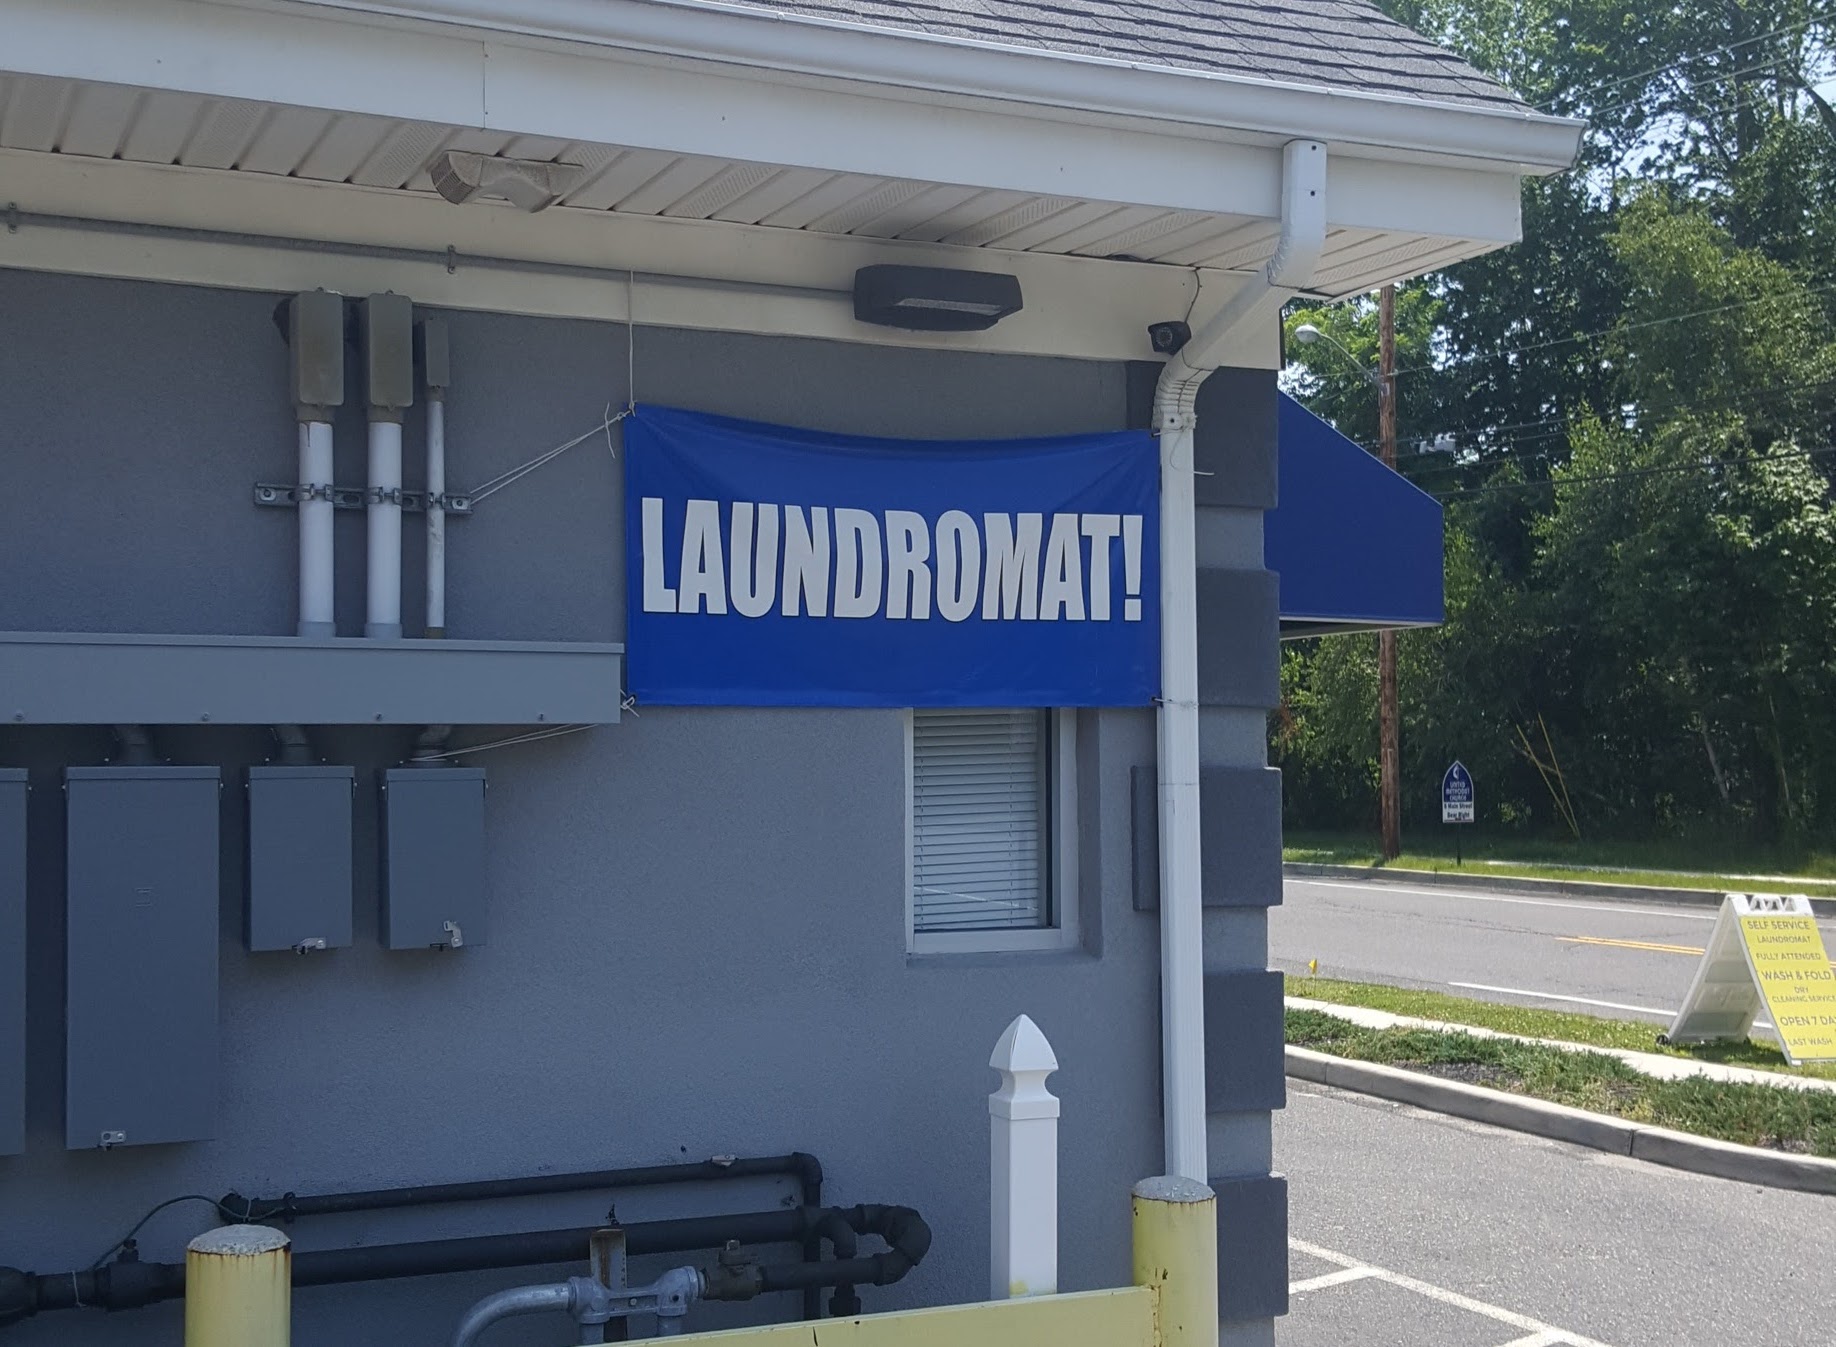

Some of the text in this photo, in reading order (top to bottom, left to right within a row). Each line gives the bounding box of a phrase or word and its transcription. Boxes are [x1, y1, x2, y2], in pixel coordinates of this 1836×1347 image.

[641, 496, 1143, 622] LAUNDROMAT!
[1747, 920, 1810, 930] SELF SERVICE
[1757, 935, 1811, 943] LAUNDROMAT
[1756, 952, 1821, 961] FULLY ATTENDED
[1761, 970, 1831, 981] WASH & FOLD
[1772, 995, 1807, 1003] CLEANING
[1780, 1015, 1836, 1026] OPEN 7 DA
[1788, 1038, 1807, 1046] LAST
